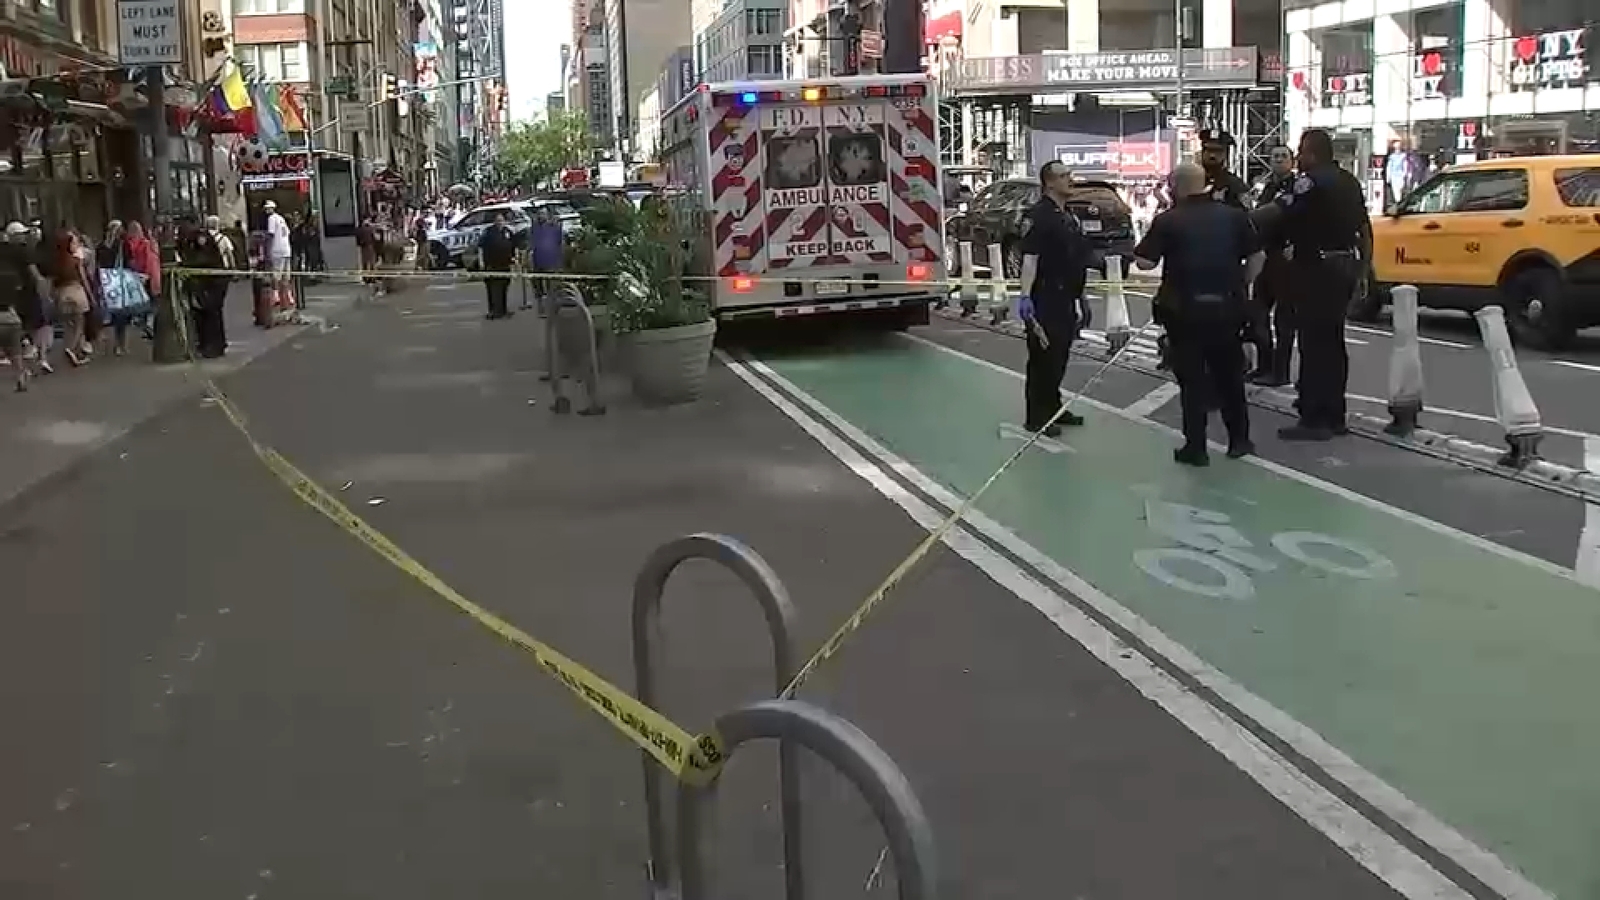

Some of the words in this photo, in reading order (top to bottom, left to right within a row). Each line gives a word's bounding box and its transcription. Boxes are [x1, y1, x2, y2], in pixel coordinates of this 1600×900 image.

[121, 7, 144, 19] LEFT
[149, 7, 175, 18] LANE
[133, 25, 165, 38] MUST
[123, 45, 150, 56] TURN
[154, 44, 178, 55] LEFT
[1541, 29, 1587, 58] NY
[1085, 54, 1127, 66] OFFICE
[1129, 52, 1173, 64] AHEAD.
[1047, 67, 1091, 81] MAKE
[1094, 67, 1135, 80] YOUR
[1061, 152, 1156, 166] SUFFOLK
[769, 186, 880, 207] AMBULANCE
[785, 243, 827, 256] KEEP
[834, 240, 876, 253] BACK
